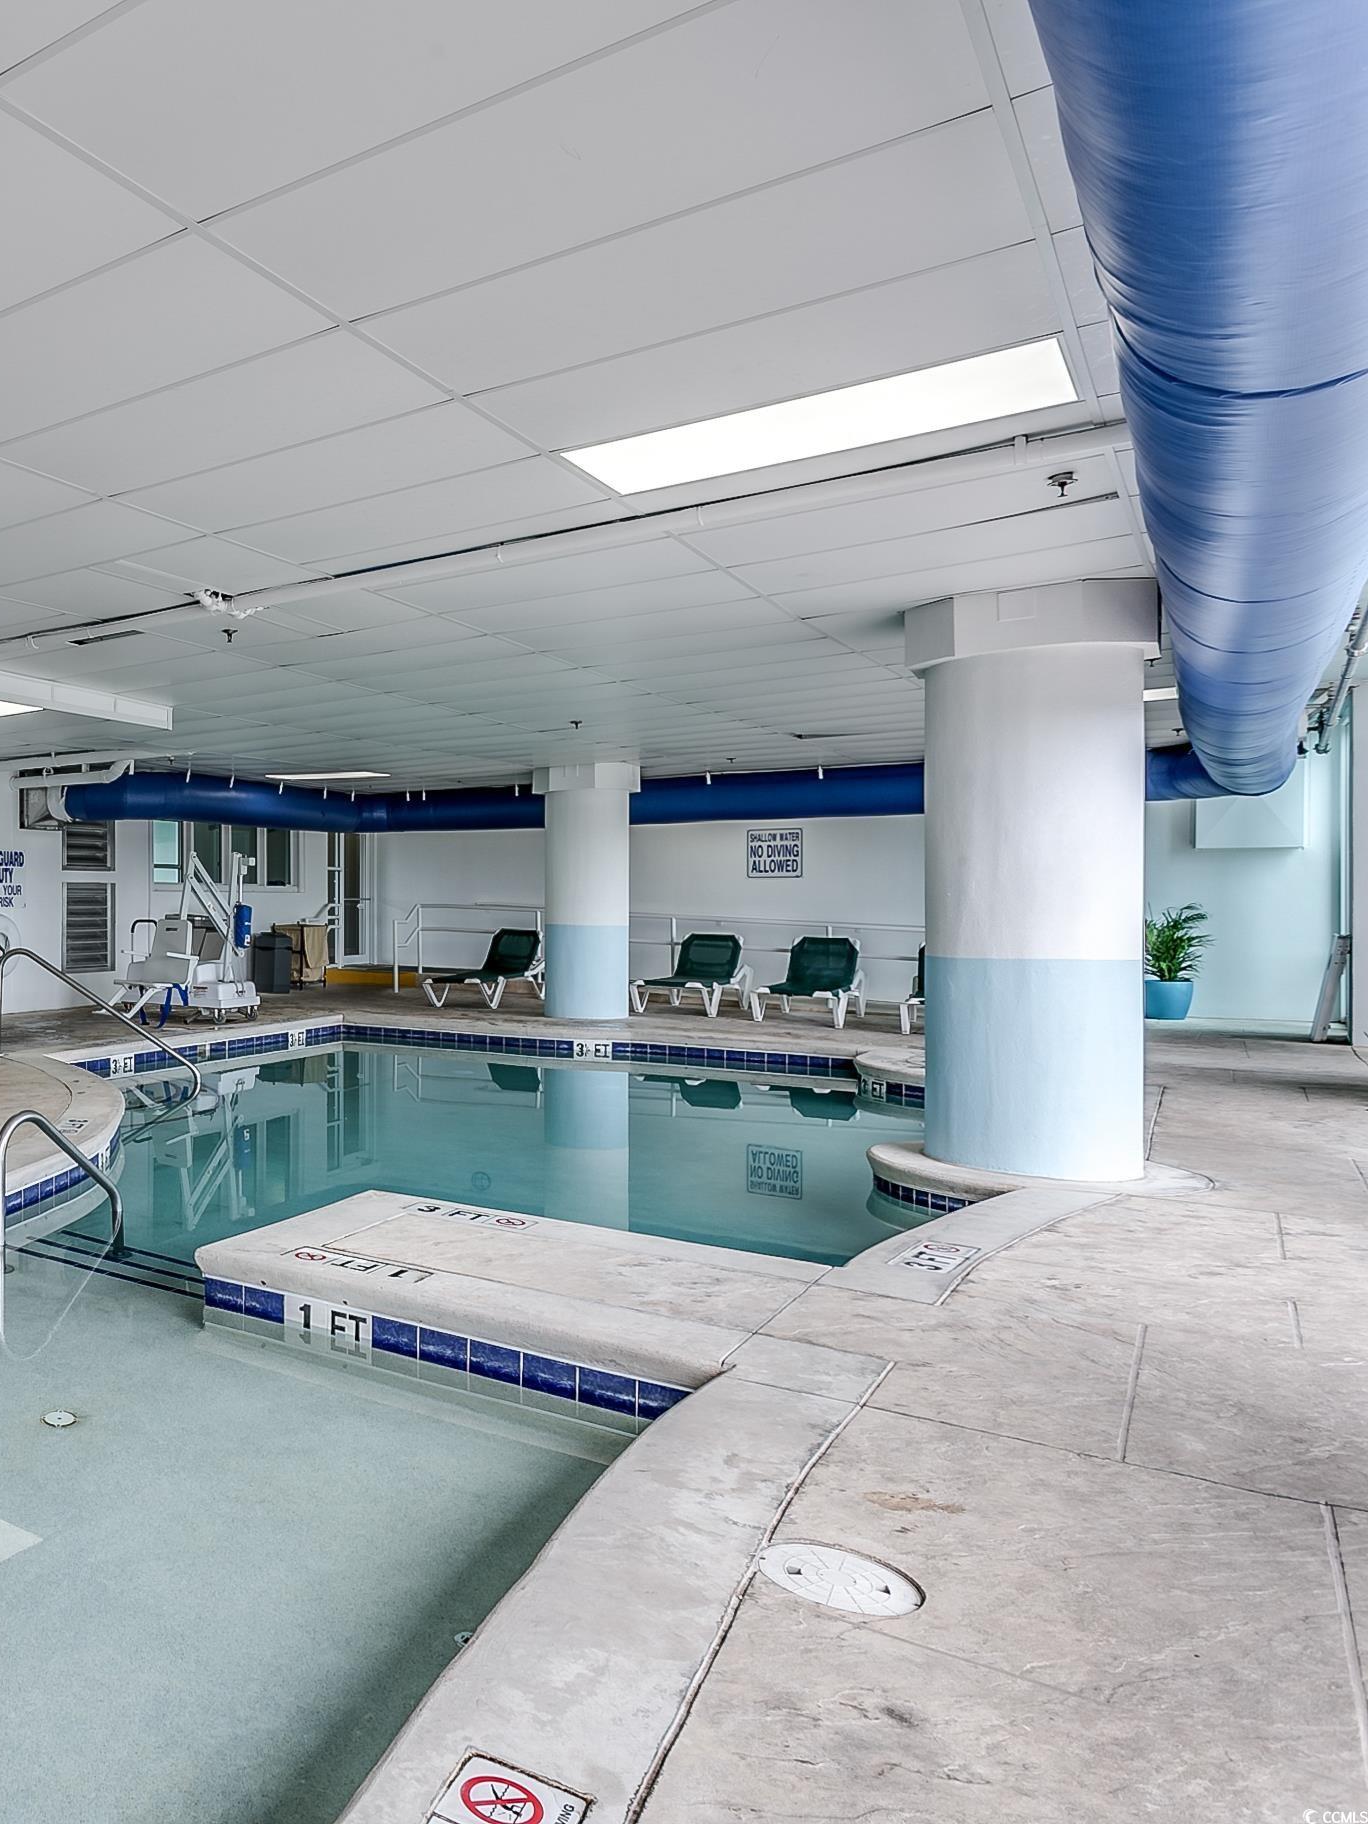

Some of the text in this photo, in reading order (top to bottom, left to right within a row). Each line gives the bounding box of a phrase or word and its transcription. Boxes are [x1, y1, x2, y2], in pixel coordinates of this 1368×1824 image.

[750, 832, 799, 842] SHALLOW WATER
[750, 844, 799, 858] NO DIVING
[751, 859, 798, 873] ALLOWED
[3, 885, 22, 895] YOUR
[417, 1205, 491, 1220] 3 FT
[299, 1304, 367, 1341] 1 FT
